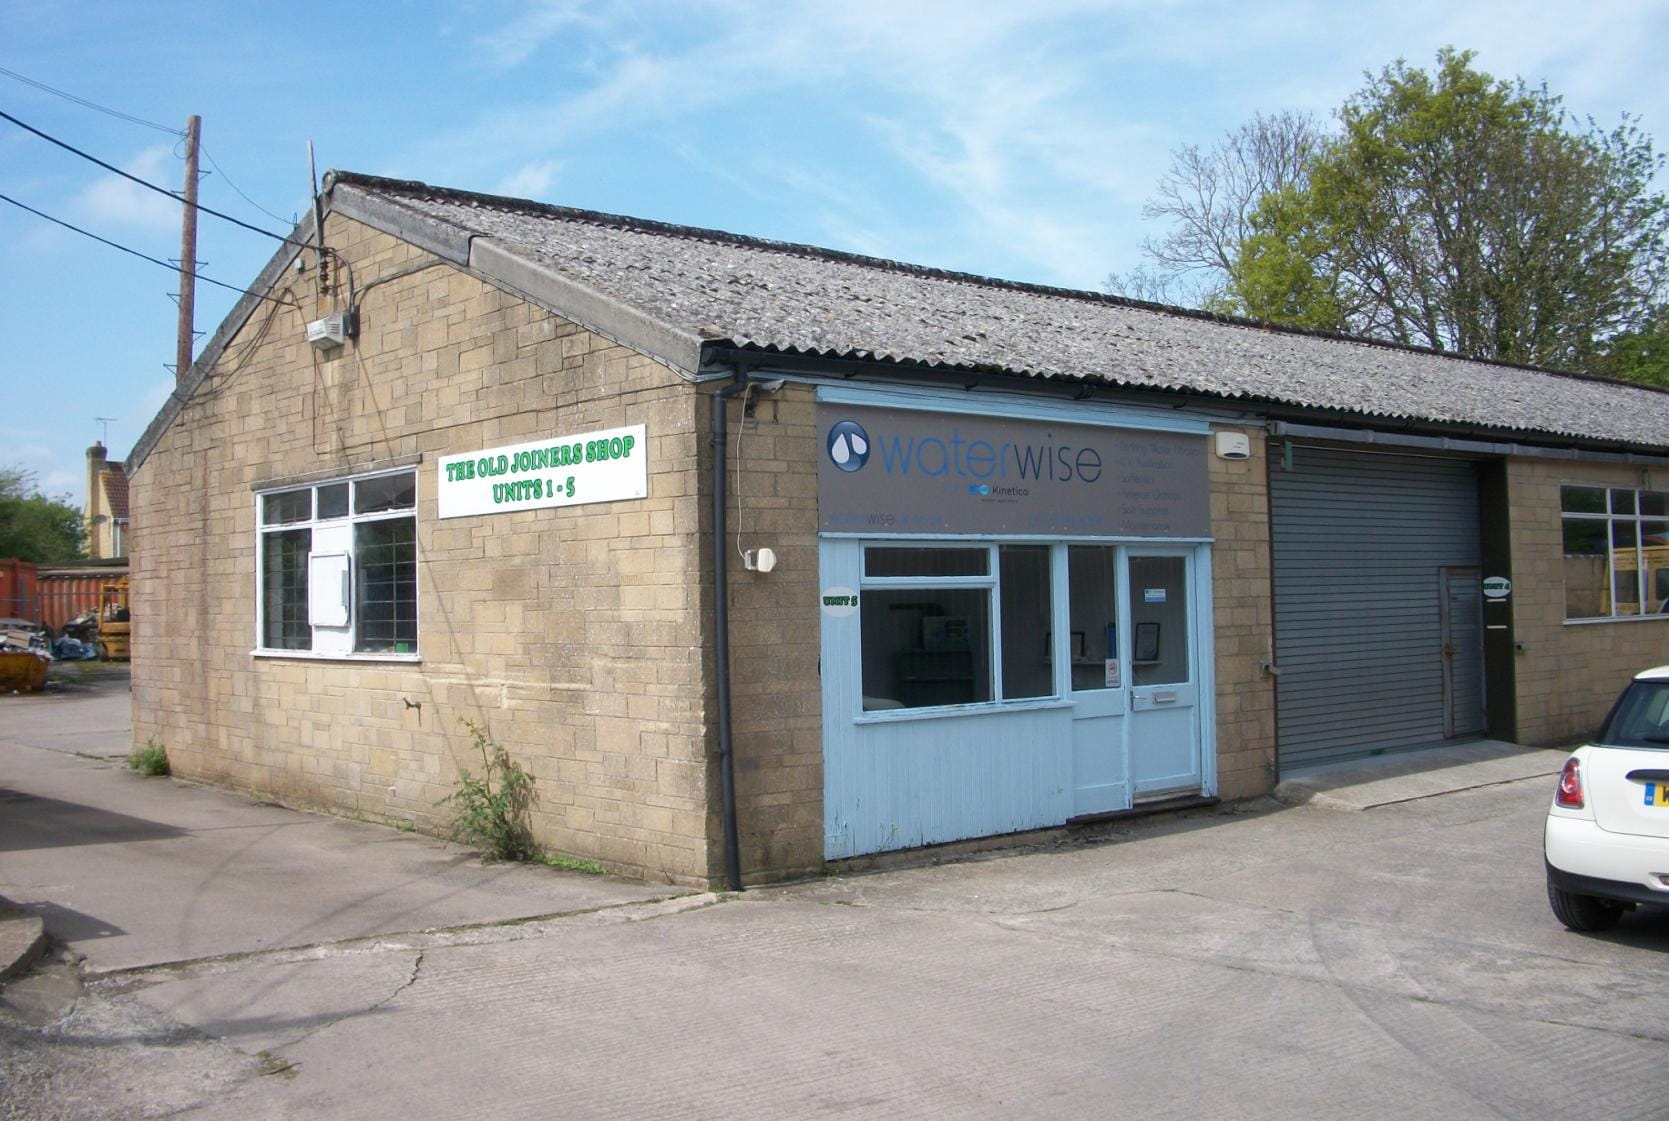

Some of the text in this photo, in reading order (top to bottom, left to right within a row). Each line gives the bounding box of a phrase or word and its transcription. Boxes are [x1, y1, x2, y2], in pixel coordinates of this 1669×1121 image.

[446, 435, 635, 482] THE OLD JOINERS SHOP
[879, 428, 1102, 483] waterwise
[492, 479, 543, 504] UNITS
[546, 479, 554, 498] 1
[566, 476, 576, 497] 5
[992, 484, 1030, 497] Kinetico
[823, 596, 850, 606] UNIT
